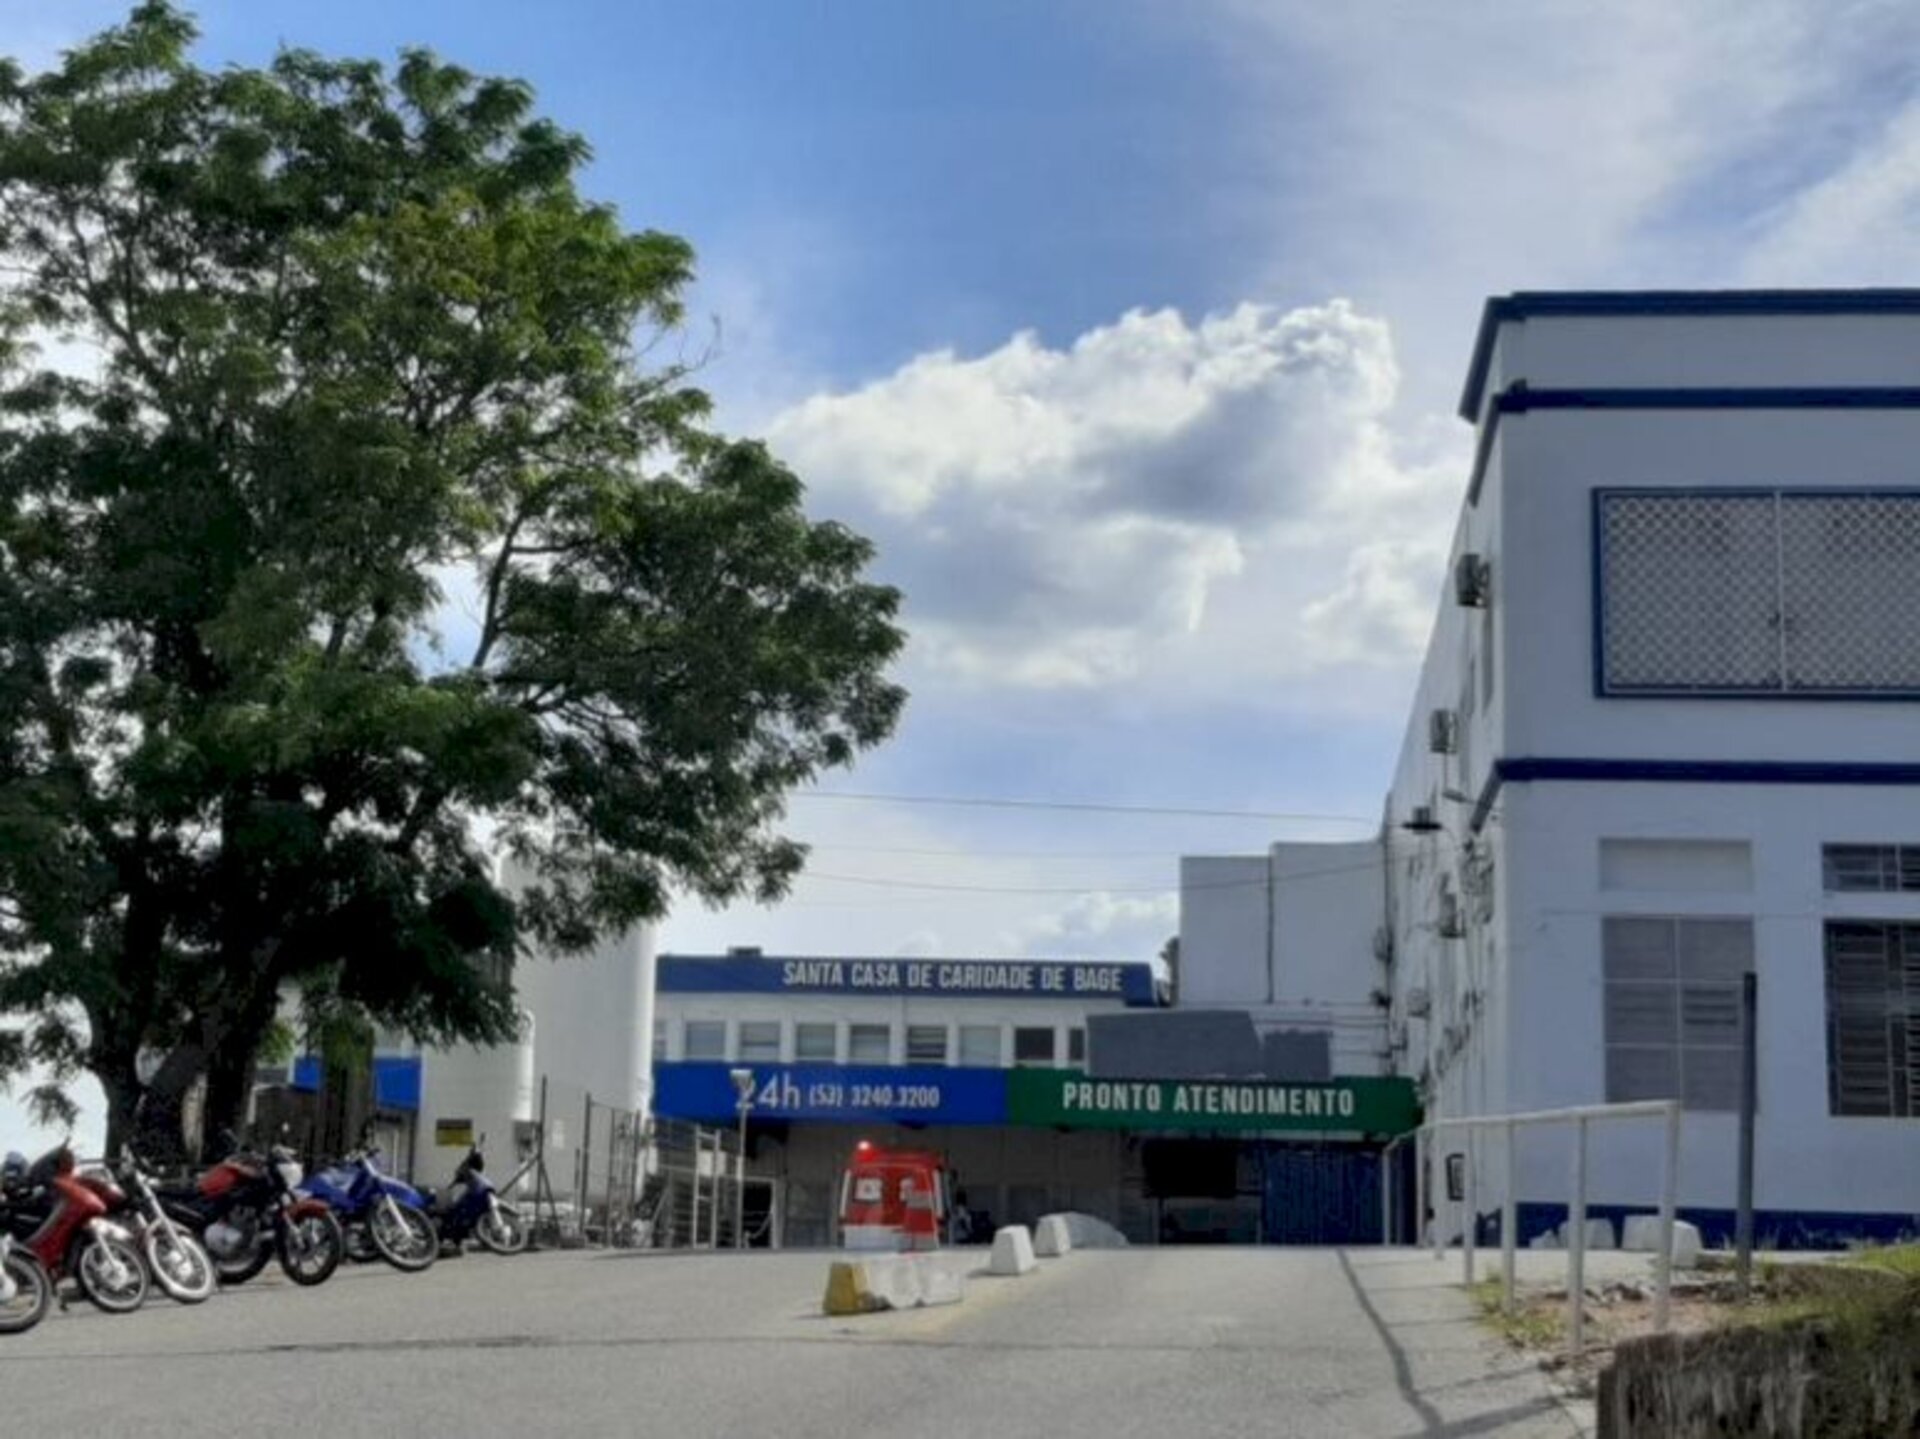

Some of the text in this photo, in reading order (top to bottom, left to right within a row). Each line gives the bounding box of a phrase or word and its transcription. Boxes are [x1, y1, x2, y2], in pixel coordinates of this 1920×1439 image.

[783, 961, 843, 986] SANTA
[851, 962, 899, 987] CASA
[907, 964, 932, 988] DE
[938, 964, 1034, 990] CARIDADE
[1041, 966, 1065, 991] DE
[809, 1084, 843, 1107] (53)
[852, 1084, 940, 1109] 3240.3200
[1062, 1081, 1356, 1117] PRONTO ATENDIMENTO
